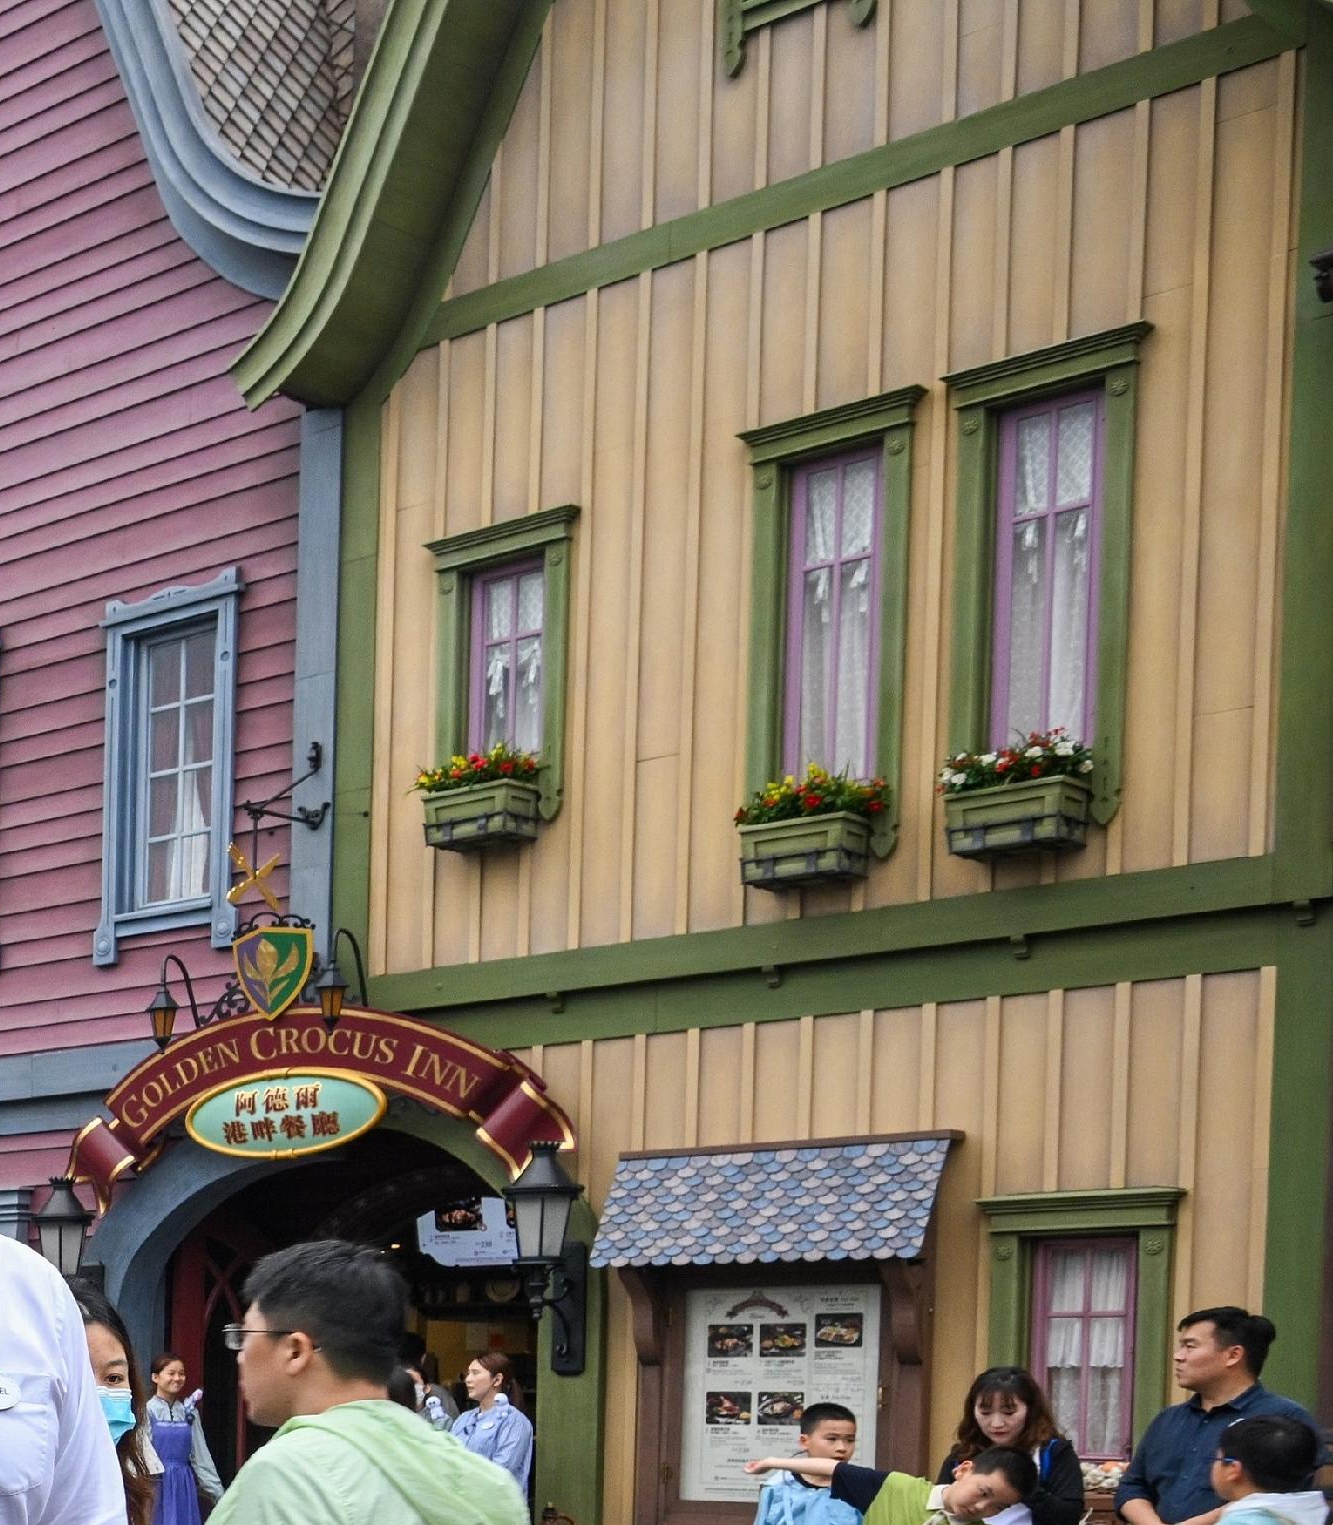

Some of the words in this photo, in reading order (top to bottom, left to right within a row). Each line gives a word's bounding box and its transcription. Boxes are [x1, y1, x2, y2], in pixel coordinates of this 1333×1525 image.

[120, 1039, 240, 1129] GOLDEN
[250, 1026, 399, 1065] CROCUS
[401, 1044, 483, 1101] INN
[235, 1082, 322, 1117] 阿德爾
[223, 1110, 341, 1146] 港畔餐廳
